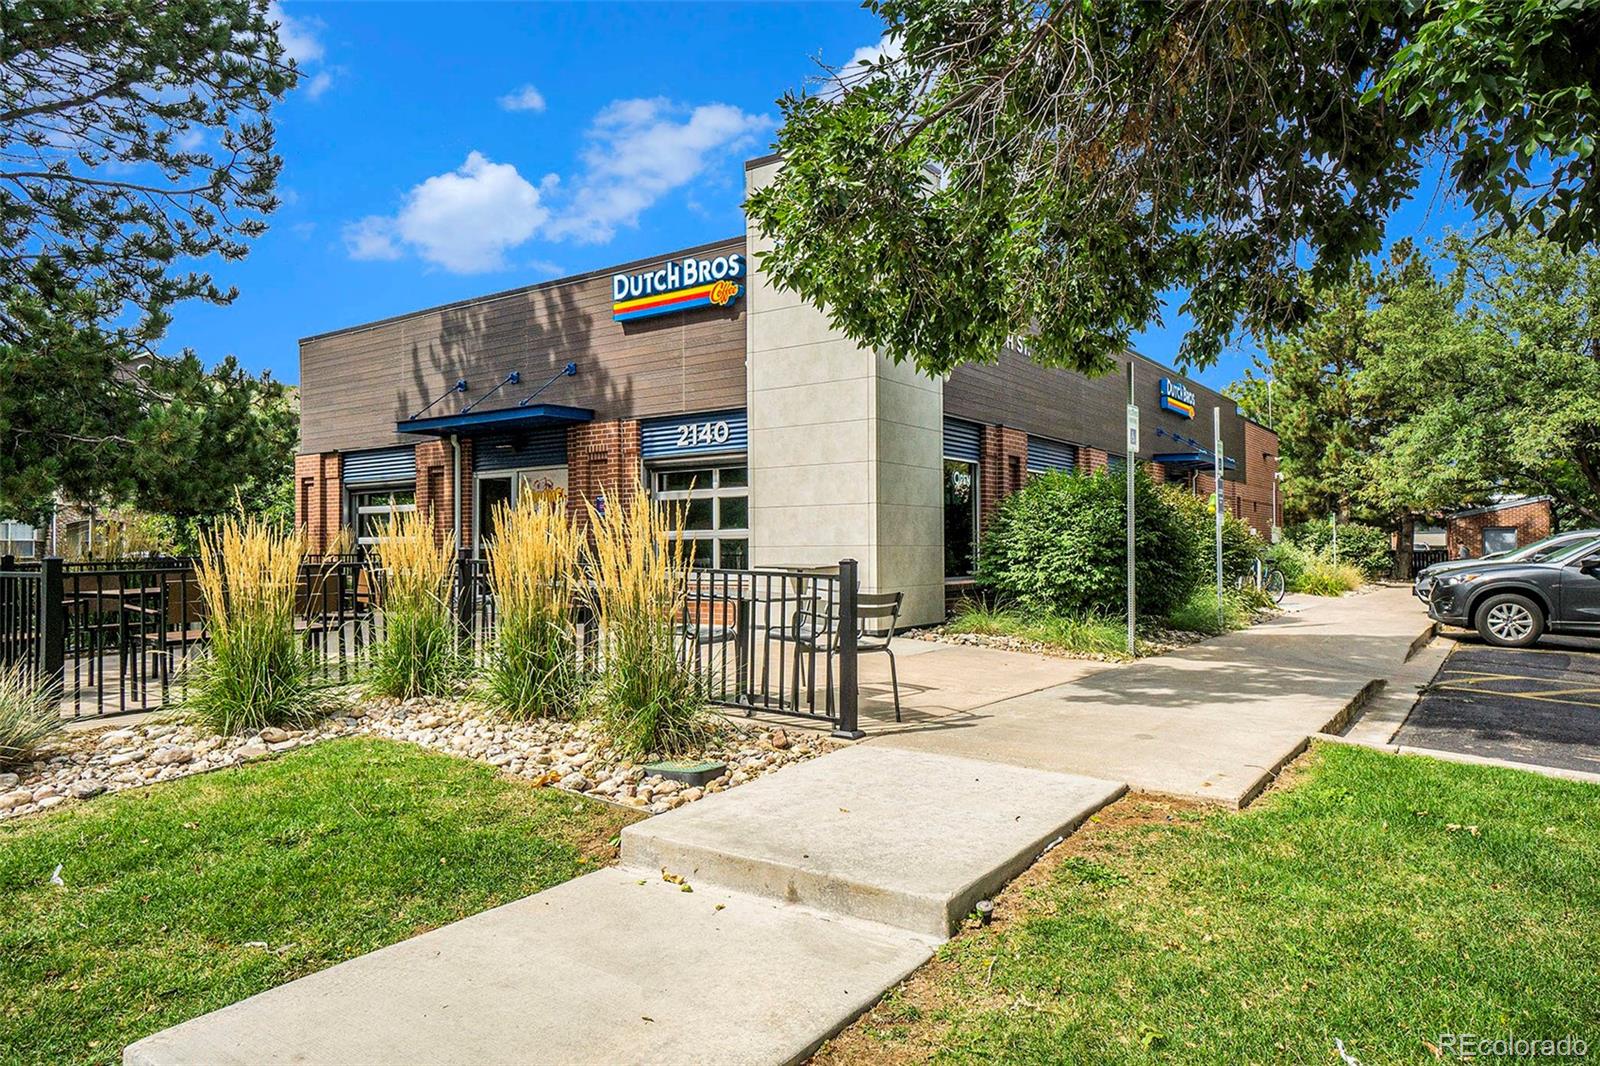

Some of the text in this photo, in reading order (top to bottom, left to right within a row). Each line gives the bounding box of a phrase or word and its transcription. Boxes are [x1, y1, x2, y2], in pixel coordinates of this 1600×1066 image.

[613, 253, 740, 301] DUTCH BROS
[710, 280, 738, 305] Coffee
[676, 420, 729, 447] 2140
